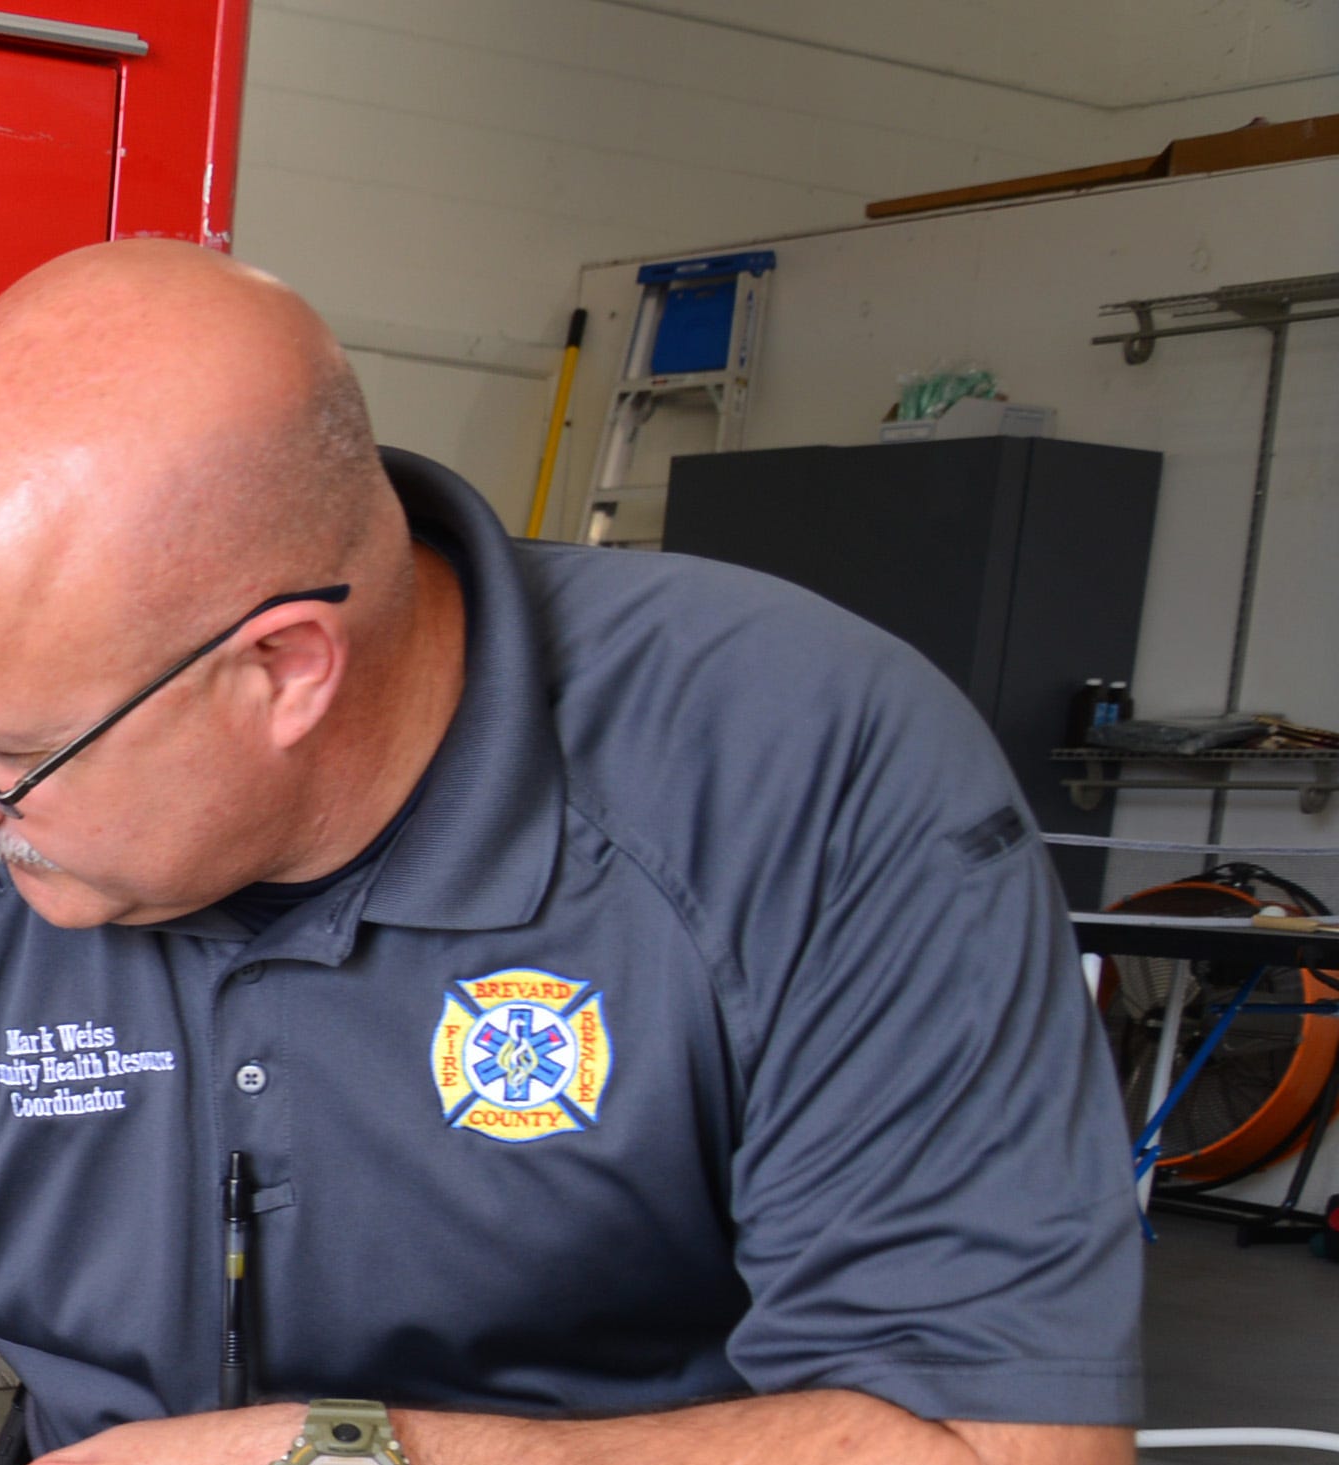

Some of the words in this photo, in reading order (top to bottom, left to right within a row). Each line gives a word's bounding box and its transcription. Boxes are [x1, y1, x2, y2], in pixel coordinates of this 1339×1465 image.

[475, 982, 571, 999] BREVARD
[5, 1026, 56, 1056] Mark
[56, 1020, 116, 1051] Weiss
[40, 1052, 106, 1084] Health
[442, 1025, 460, 1087] FIRE
[578, 1011, 596, 1102] RESCUE
[10, 1087, 126, 1118] Coordinator
[468, 1110, 563, 1127] COUNTY
